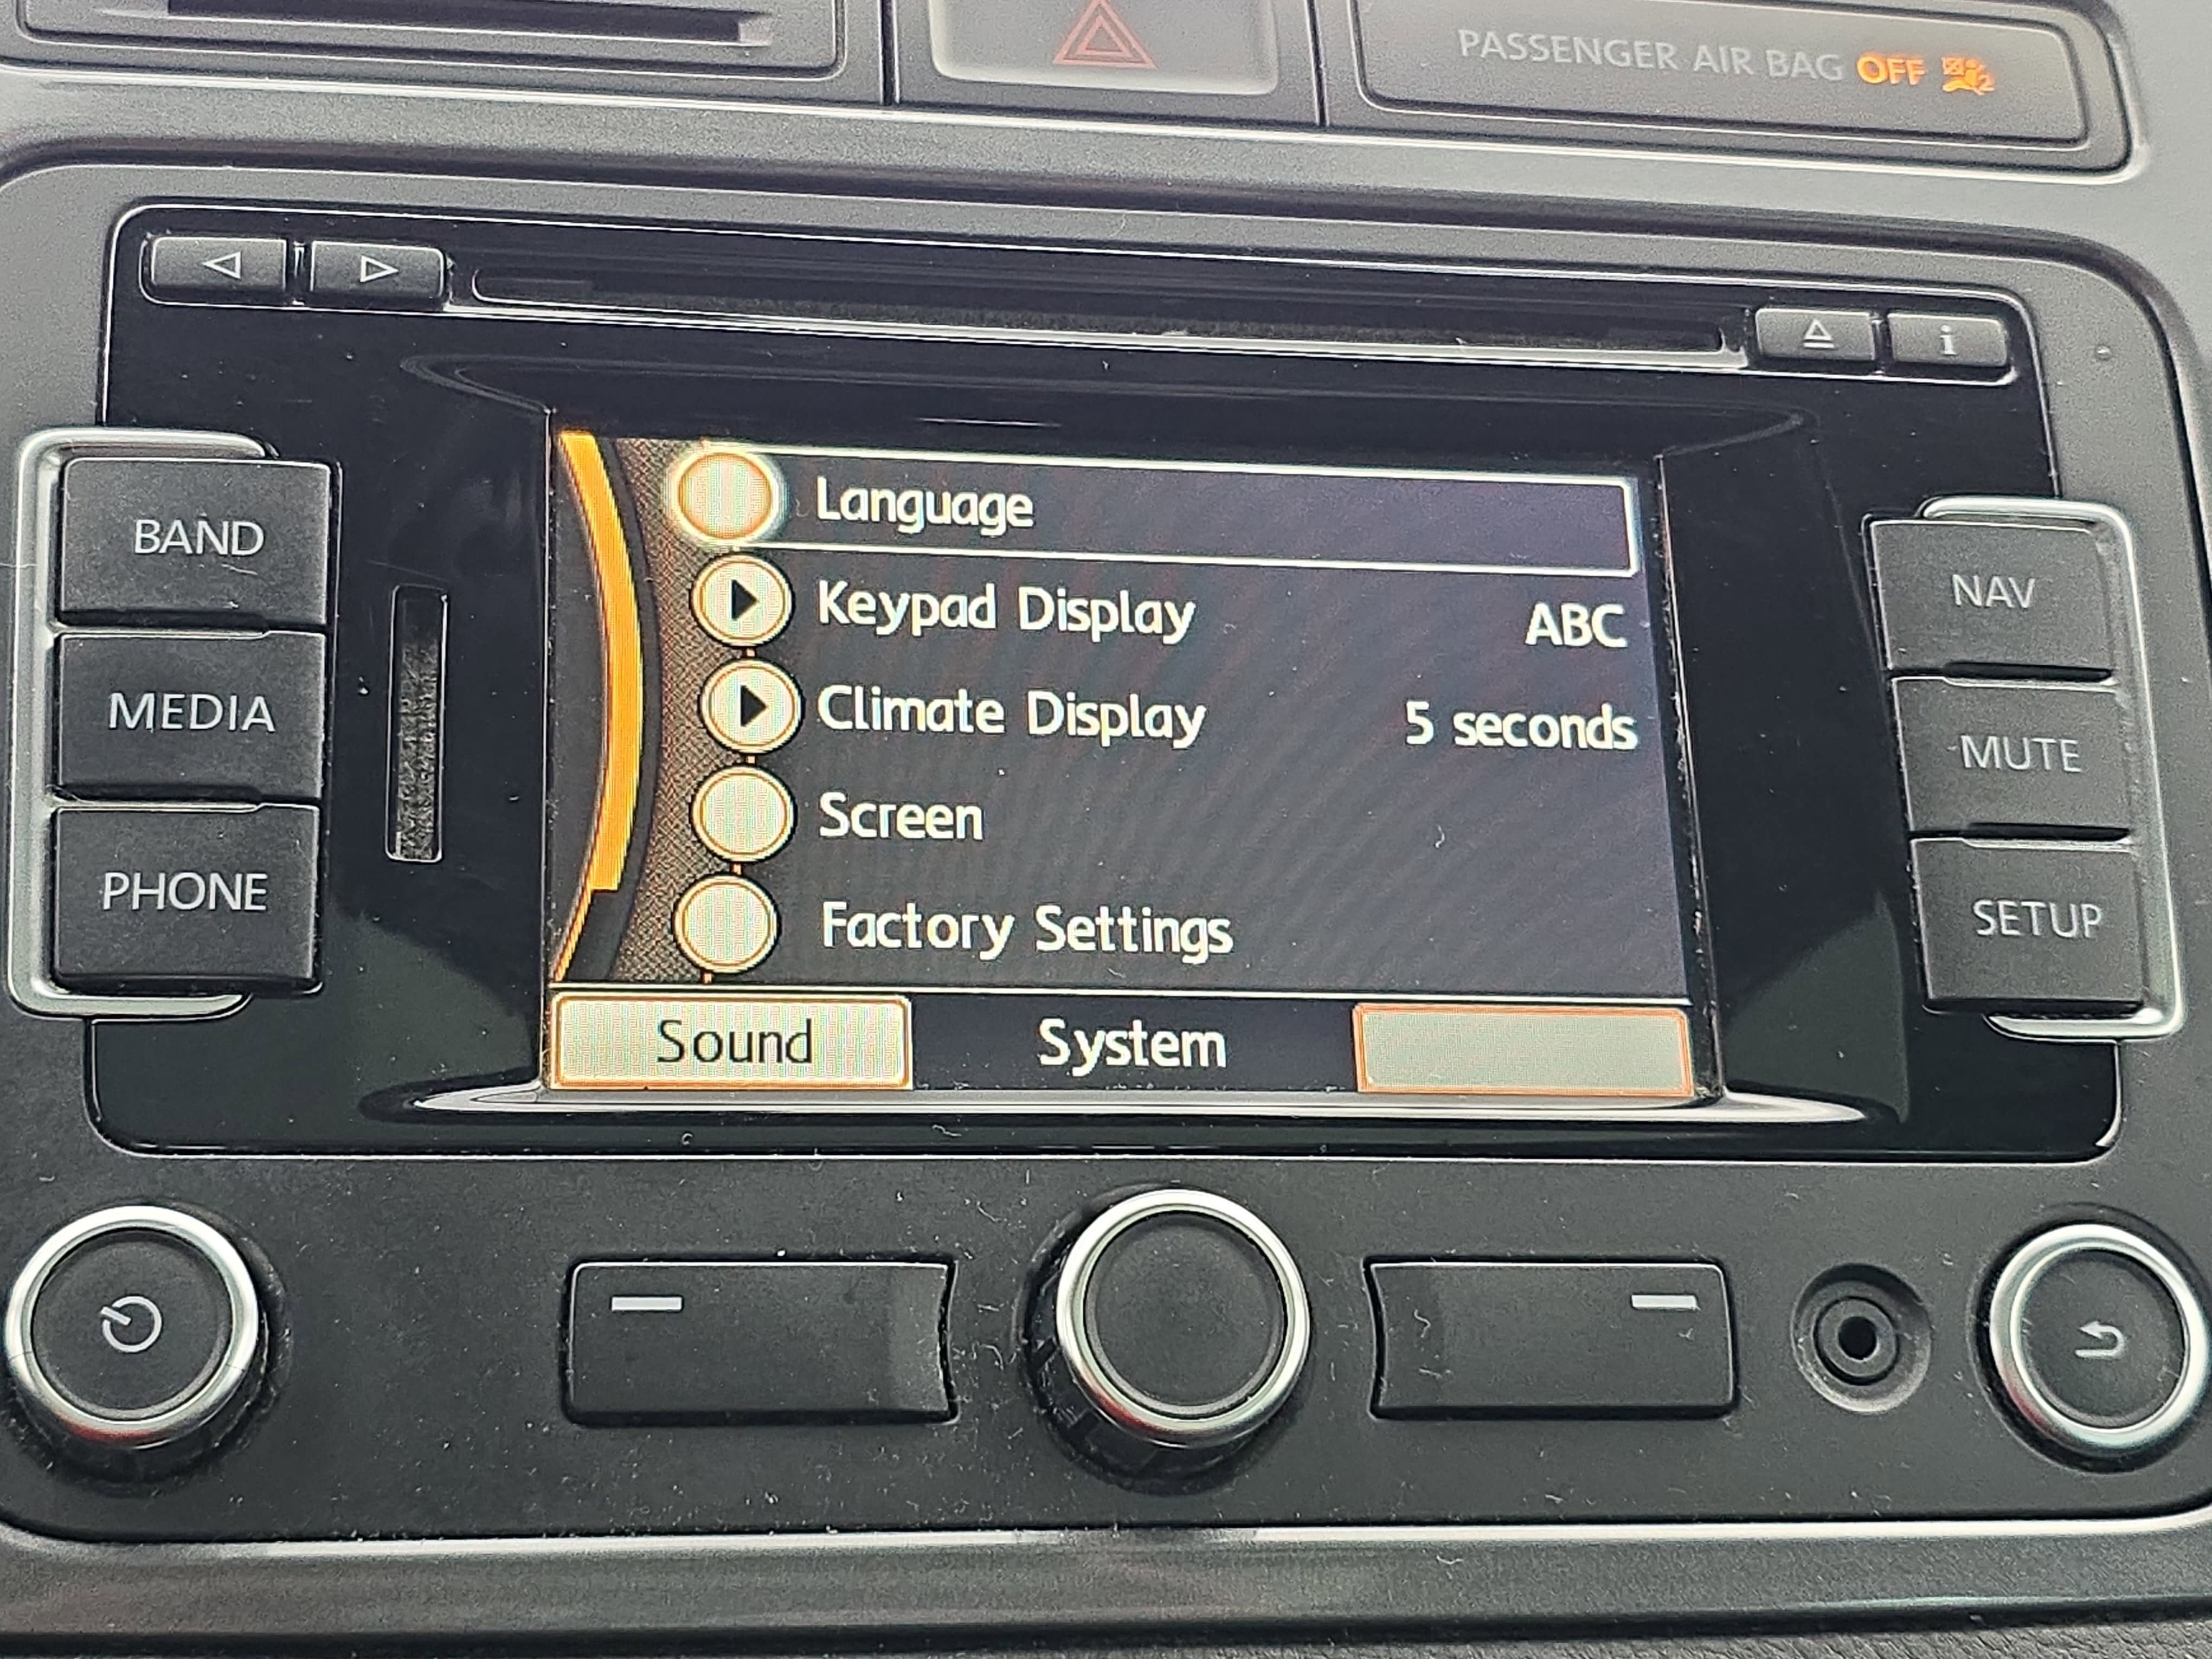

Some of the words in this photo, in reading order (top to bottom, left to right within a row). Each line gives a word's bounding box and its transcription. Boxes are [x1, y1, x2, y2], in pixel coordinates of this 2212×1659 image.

[1458, 29, 1678, 70] PASSENGER
[1693, 44, 1751, 76] AIR
[1765, 49, 1843, 82] BAG
[1856, 53, 1925, 86] OFF
[815, 476, 1034, 537] Language
[133, 519, 265, 556] BAND
[817, 578, 997, 636] Keypad
[1018, 586, 1196, 645] Display
[1952, 573, 2035, 609] NAV
[1525, 602, 1628, 648] ABC
[108, 692, 276, 732] MEDIA
[816, 684, 1005, 735] Climate
[1027, 690, 1206, 749] Display
[1405, 700, 1435, 745] 5
[1452, 702, 1639, 750] seconds
[1960, 734, 2082, 773] MUTE
[819, 792, 984, 841] Screen
[102, 872, 267, 912] PHONE
[822, 901, 1015, 960] Factory
[1034, 904, 1235, 965] Settings
[1972, 898, 2103, 938] SETUP
[657, 1018, 814, 1066] Sound
[1038, 1017, 1227, 1077] System
